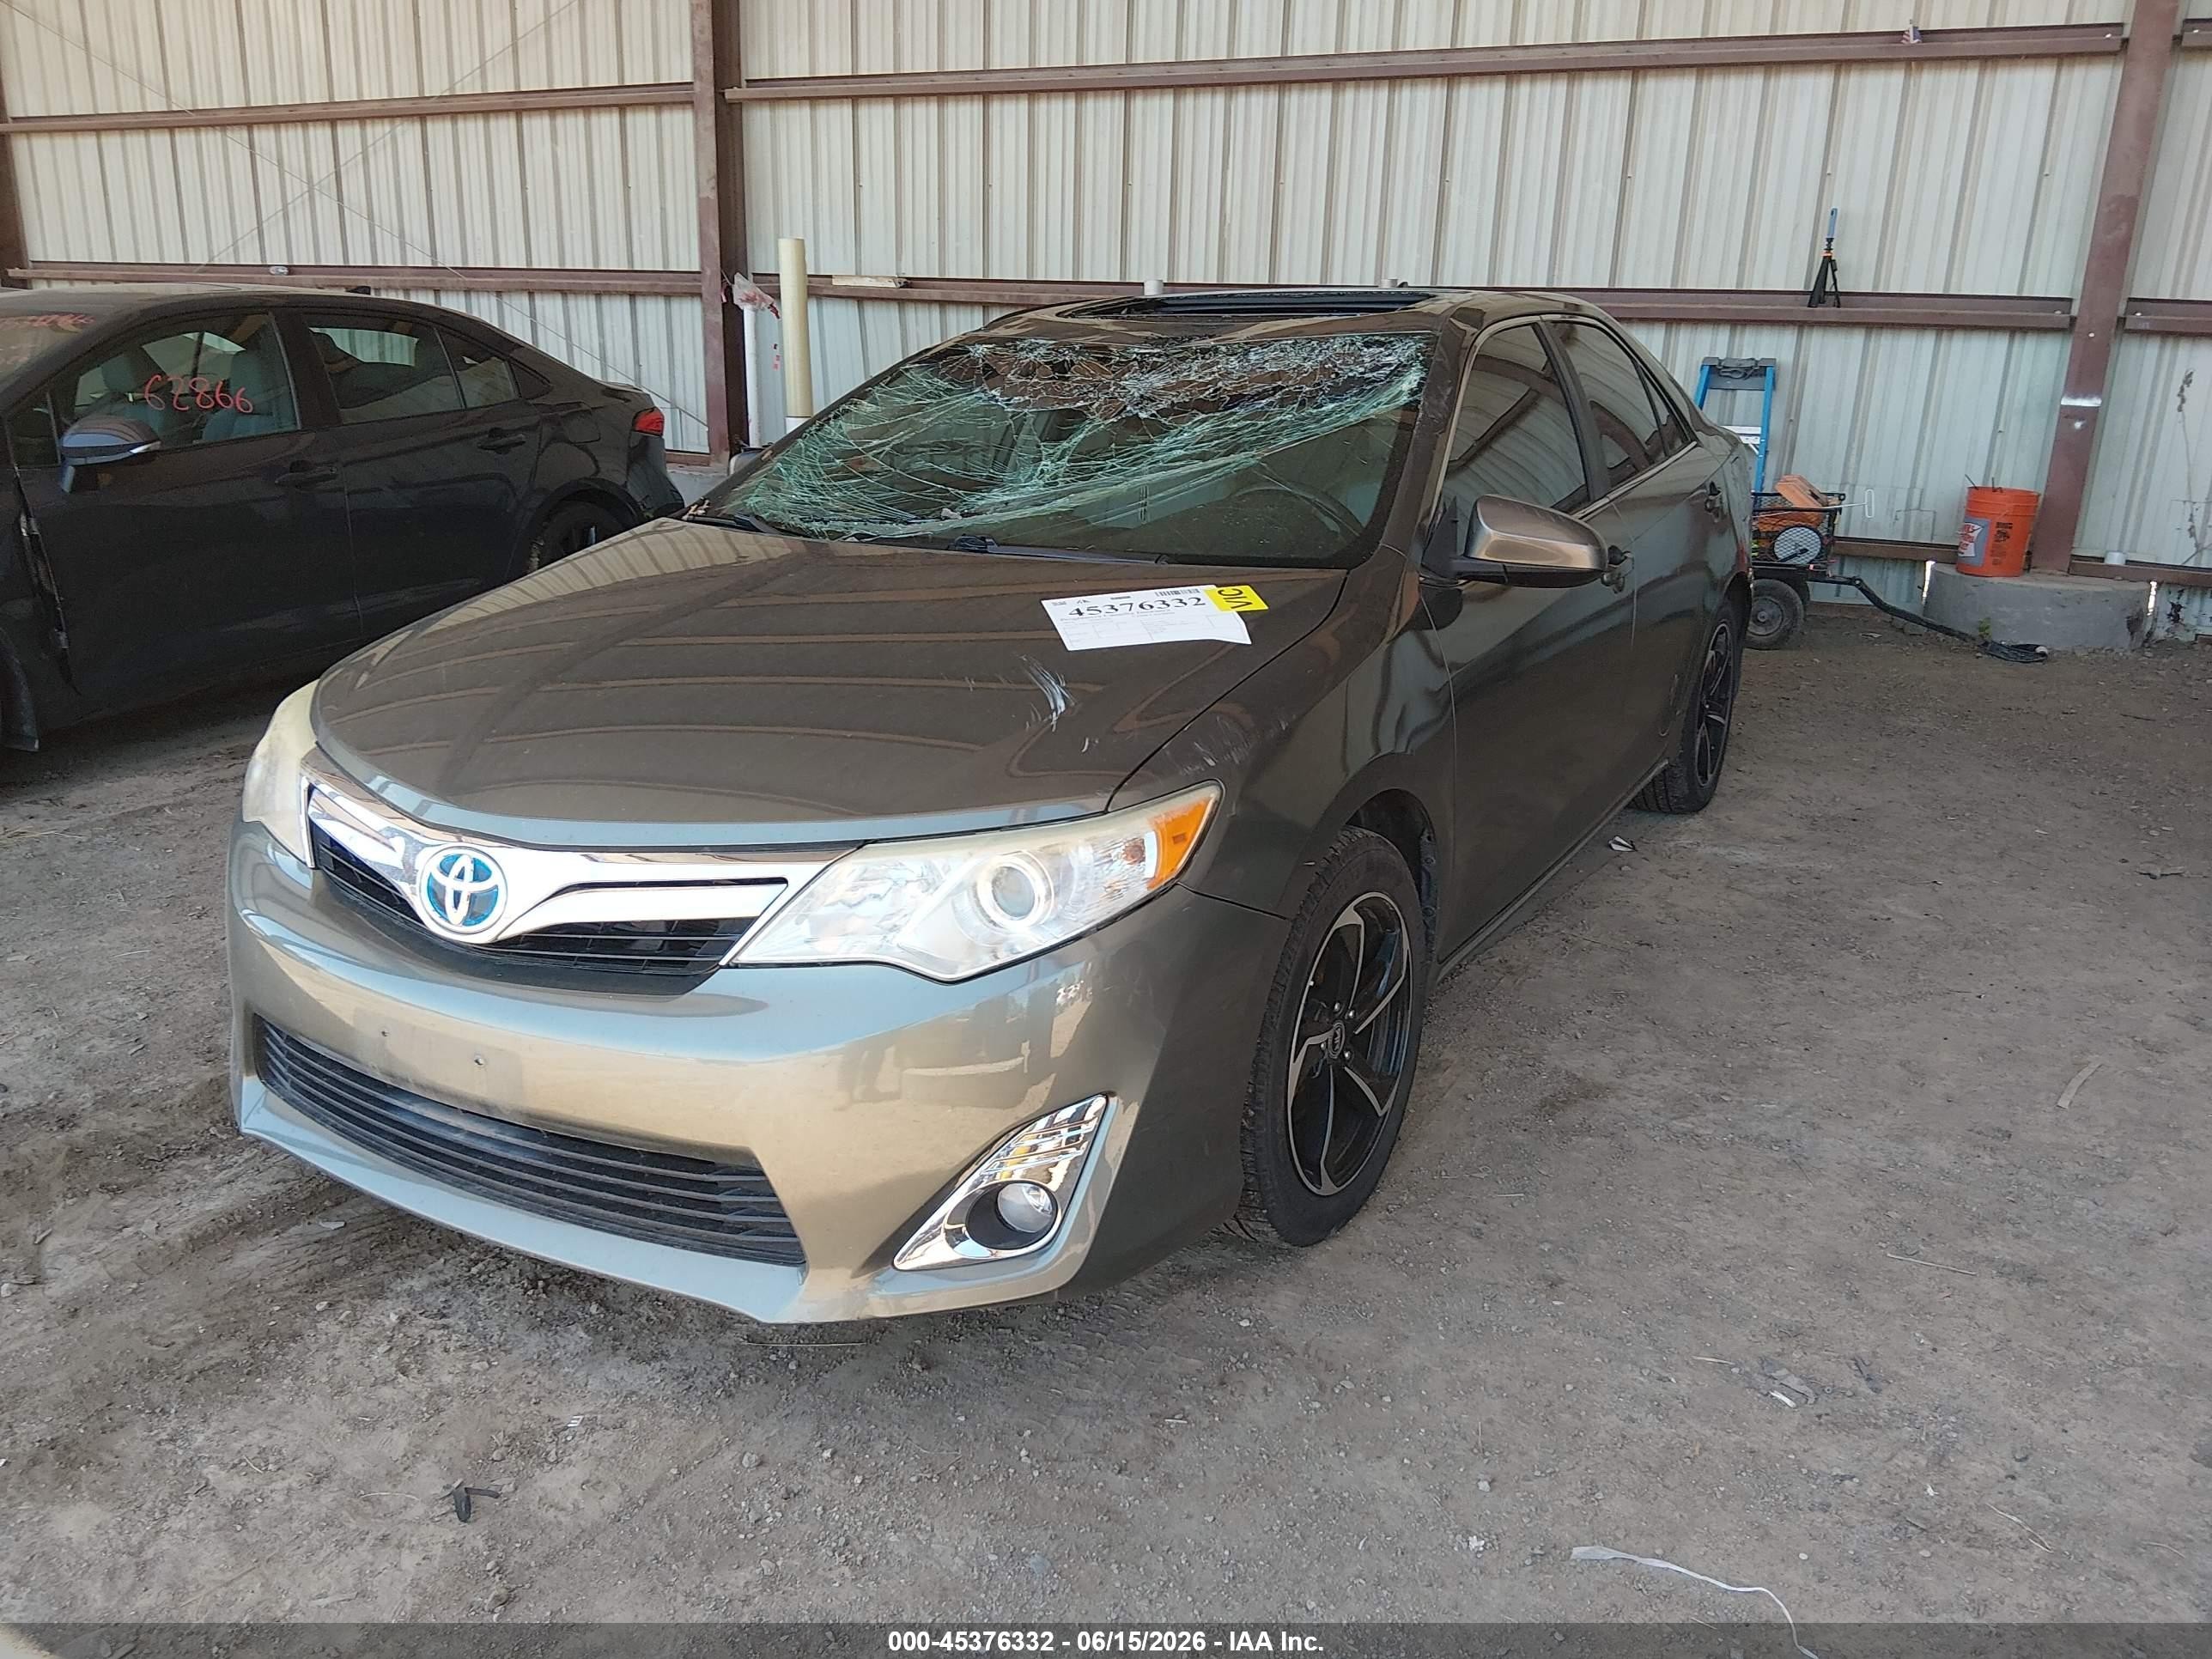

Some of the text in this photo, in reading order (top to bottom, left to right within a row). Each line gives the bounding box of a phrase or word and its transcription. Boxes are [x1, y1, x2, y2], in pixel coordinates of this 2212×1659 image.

[143, 374, 254, 414] 62866
[1068, 596, 1206, 617] 45376332
[1217, 587, 1253, 610] VIC
